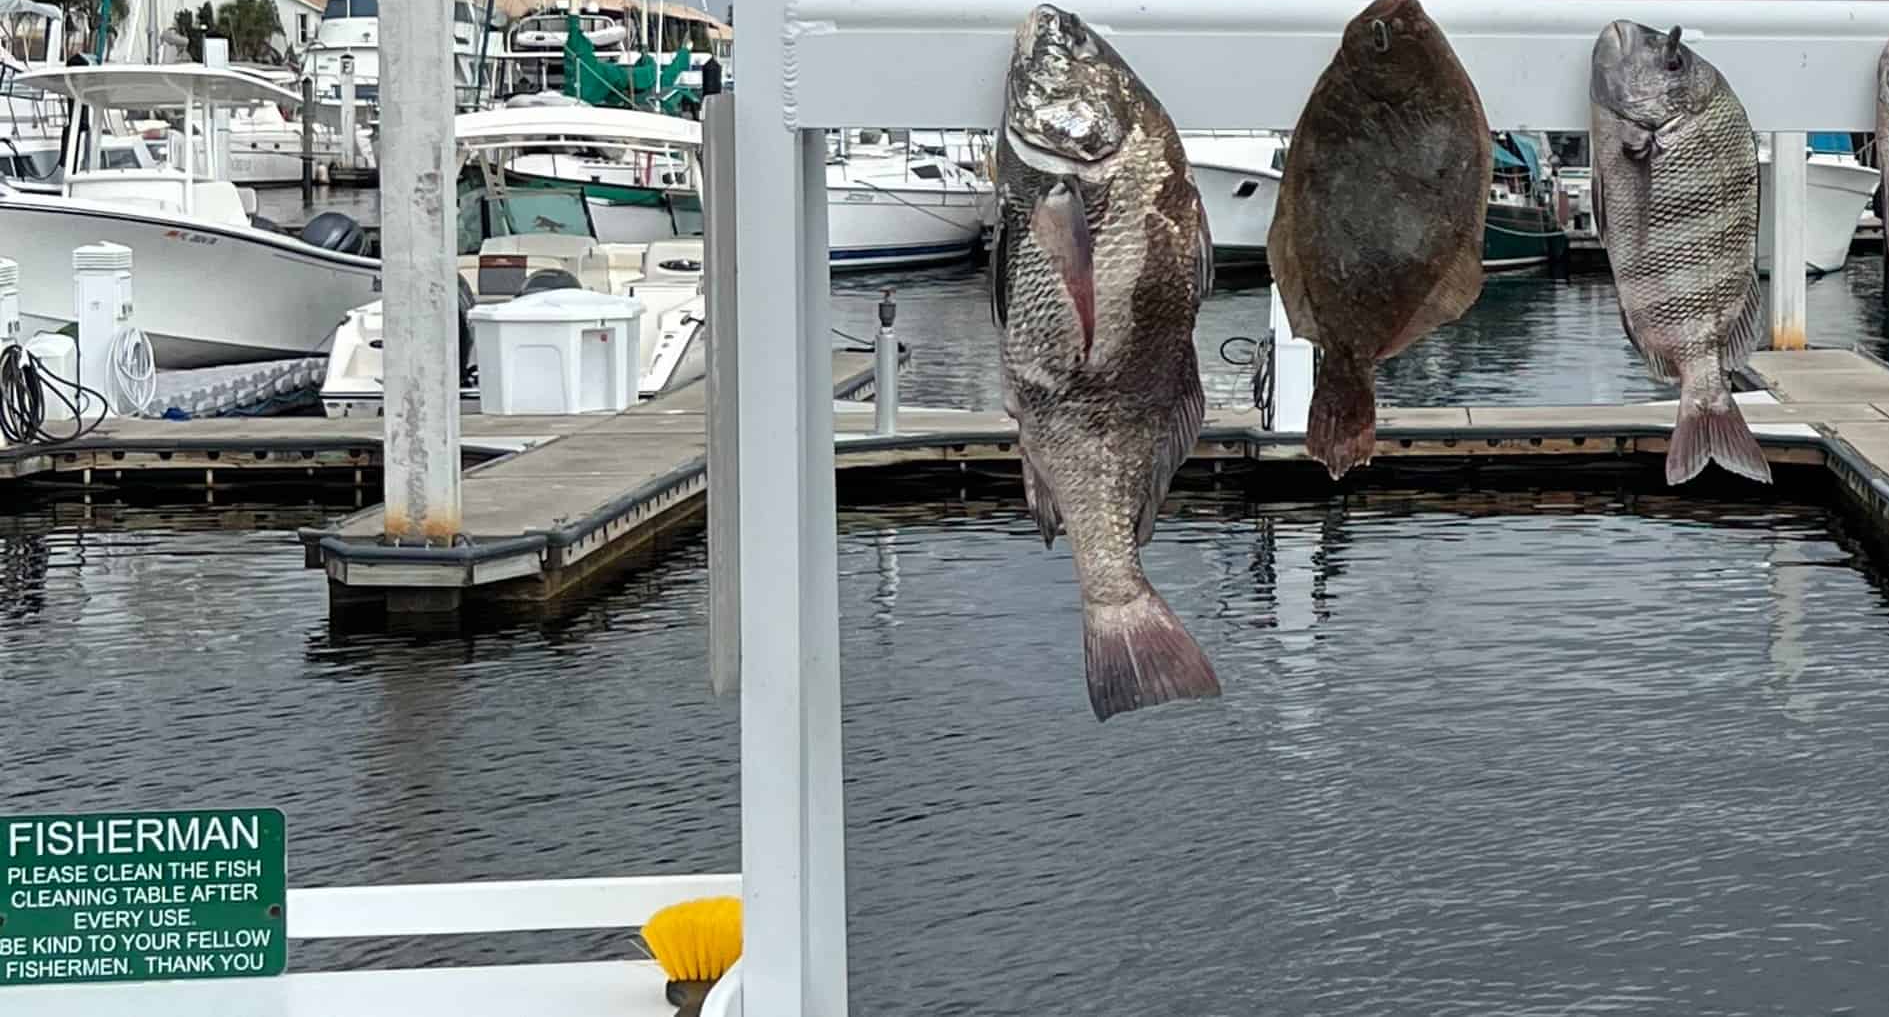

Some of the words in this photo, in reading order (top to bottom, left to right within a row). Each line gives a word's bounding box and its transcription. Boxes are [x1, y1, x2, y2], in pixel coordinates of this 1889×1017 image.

[9, 816, 259, 857] FISHERMAN
[8, 866, 88, 885] PLEASE
[94, 863, 162, 882] CLEAN
[168, 862, 209, 880] THE
[215, 860, 261, 878] FISH
[11, 888, 117, 908] CLEANING
[123, 886, 186, 904] TABLE
[191, 884, 258, 903] AFTER
[74, 911, 143, 930] EVERY
[149, 909, 196, 927] USE.
[0, 938, 27, 955] BE
[33, 935, 82, 954] KIND
[87, 934, 116, 952] TO
[121, 932, 181, 951] YOUR
[187, 930, 271, 949] FELLOW
[6, 958, 133, 979] FISHERMEN.
[144, 955, 214, 973] THANK
[220, 953, 264, 971] YOU
